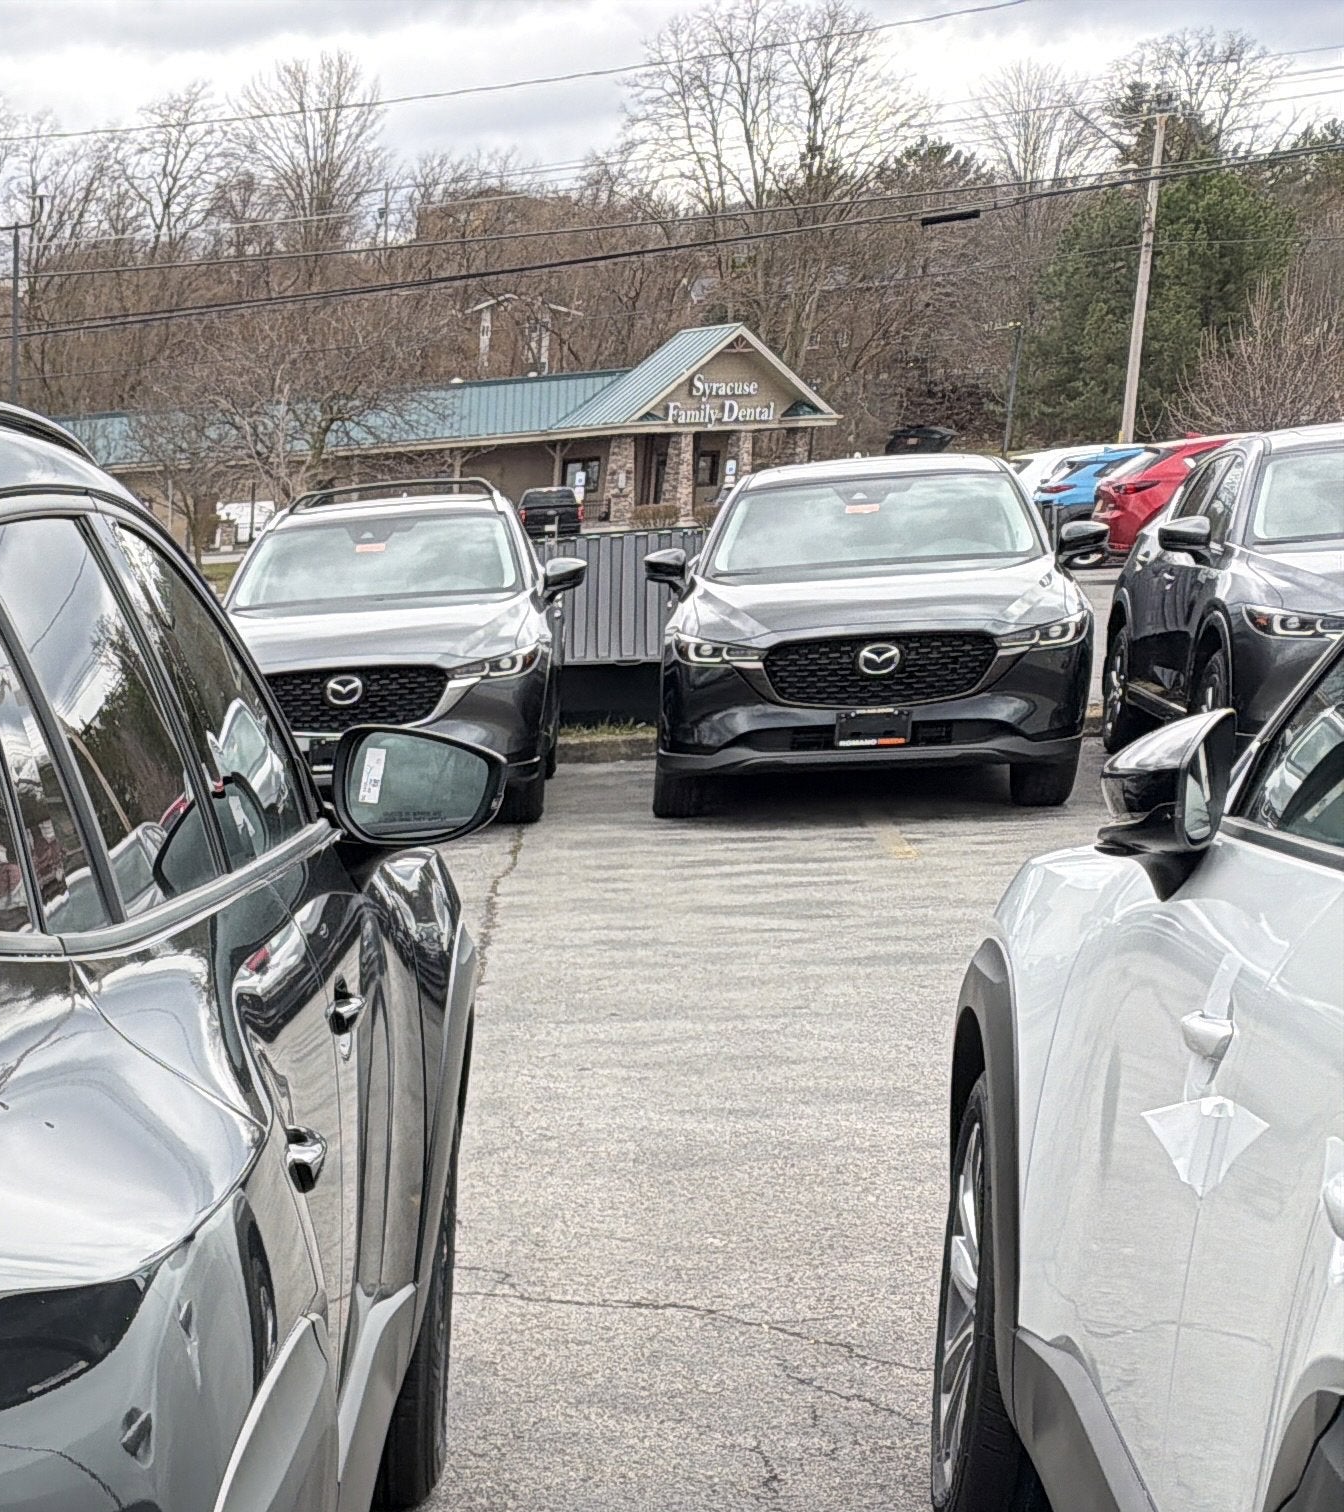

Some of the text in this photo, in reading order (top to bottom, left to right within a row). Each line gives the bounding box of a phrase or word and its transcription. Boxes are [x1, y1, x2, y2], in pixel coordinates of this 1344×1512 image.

[692, 374, 759, 401] Syracuse
[667, 399, 775, 428] Family Dental
